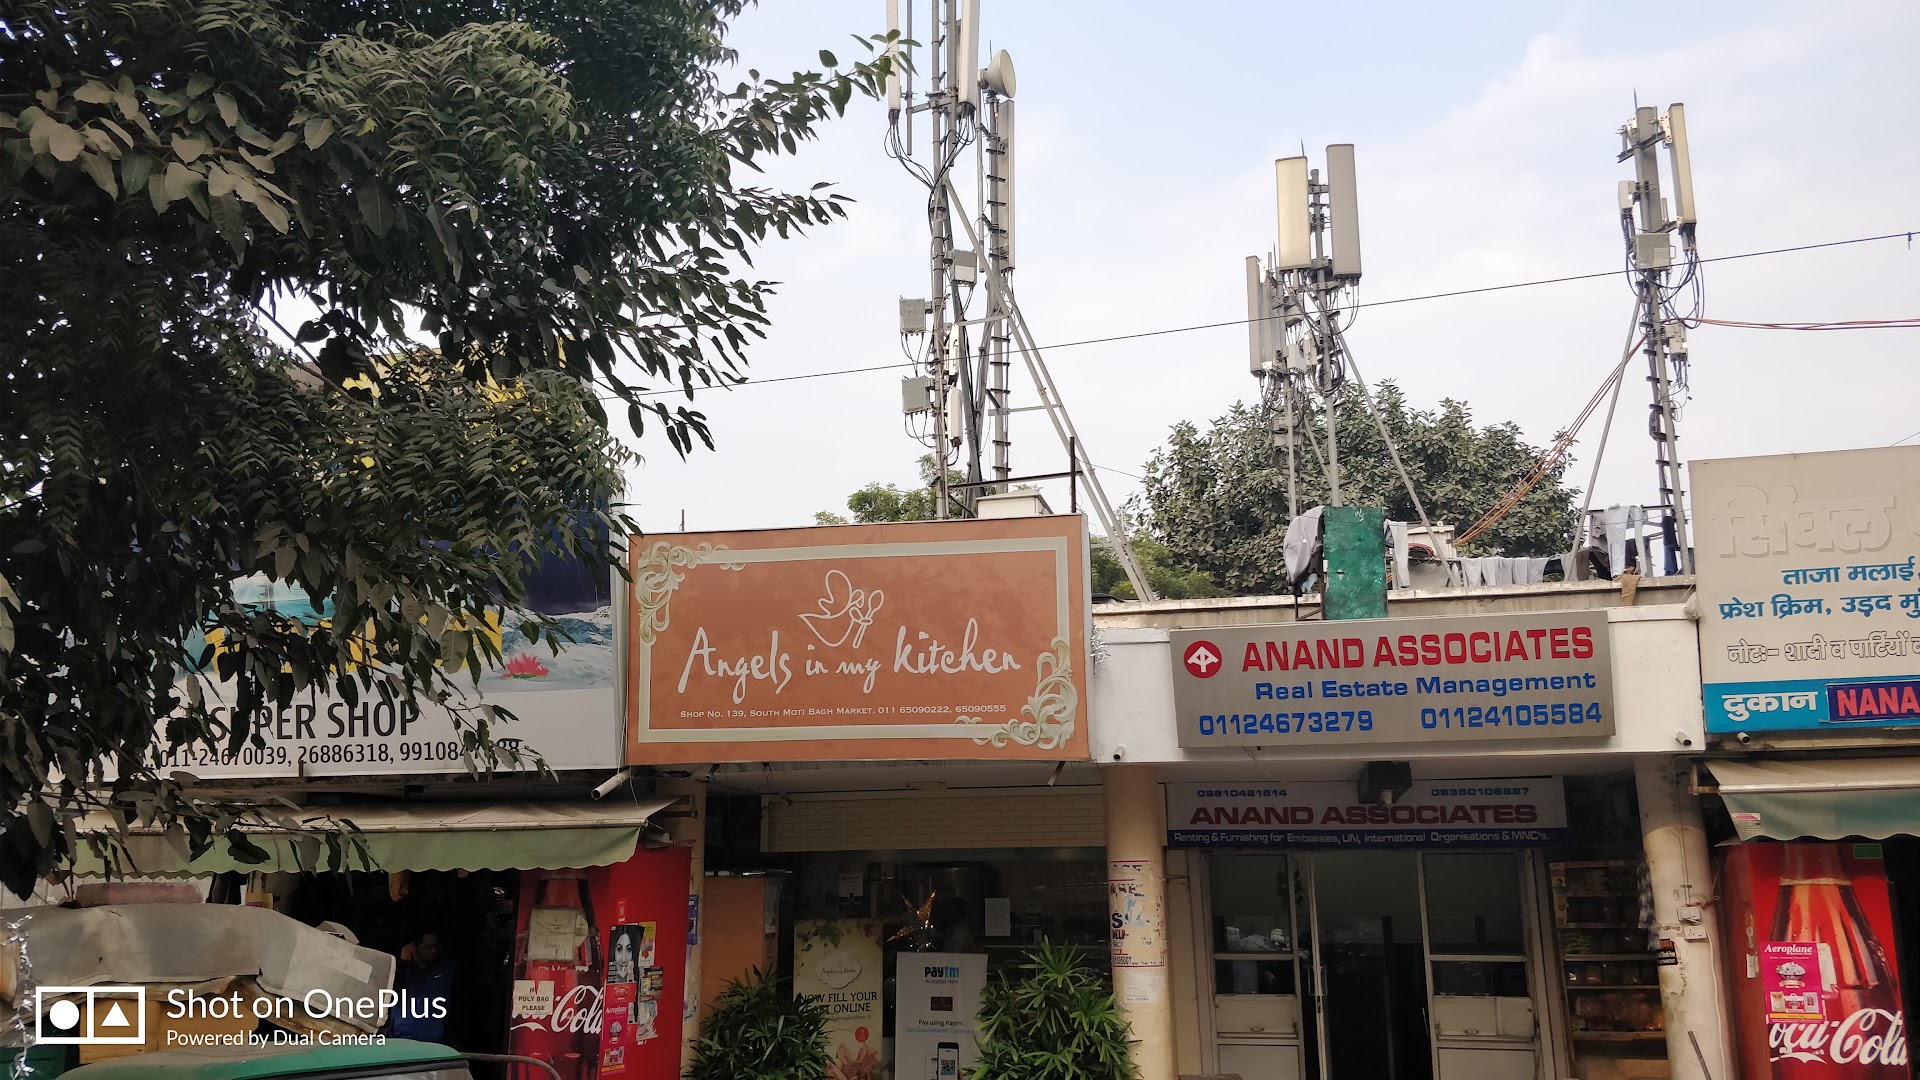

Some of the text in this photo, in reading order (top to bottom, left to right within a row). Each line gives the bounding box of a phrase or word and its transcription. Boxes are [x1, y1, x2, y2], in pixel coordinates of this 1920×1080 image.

[1781, 566, 1841, 585] ताजा
[1241, 627, 1594, 672] ANAND ASSOCIATES
[1784, 633, 1827, 661] शादी
[677, 618, 1022, 705] Angels in my kitchen
[1255, 672, 1597, 700] Real Estate Management
[726, 709, 747, 718] 139,
[877, 706, 895, 714] 011
[899, 706, 952, 714] 65090222,
[955, 704, 1006, 713] 65090555
[1721, 691, 1819, 722] दुकान
[208, 700, 420, 742] SPER SHOP
[1199, 702, 1603, 736] 01124673279 01124105584
[297, 742, 395, 765] 26886318,
[1189, 803, 1538, 825] ANAND ASSOCIATES
[1173, 832, 1210, 844] Renting
[1211, 833, 1220, 842] &
[1220, 833, 1269, 844] Furnishing
[1270, 833, 1285, 842] for
[1286, 833, 1341, 844] Embassies,
[1364, 832, 1426, 843] International
[1430, 831, 1500, 844] Organisations
[1501, 831, 1511, 841] &
[1764, 943, 1813, 955] Aeroplane
[828, 993, 848, 1002] FILL
[850, 991, 878, 1002] YOUR
[833, 1002, 871, 1013] ONLINE
